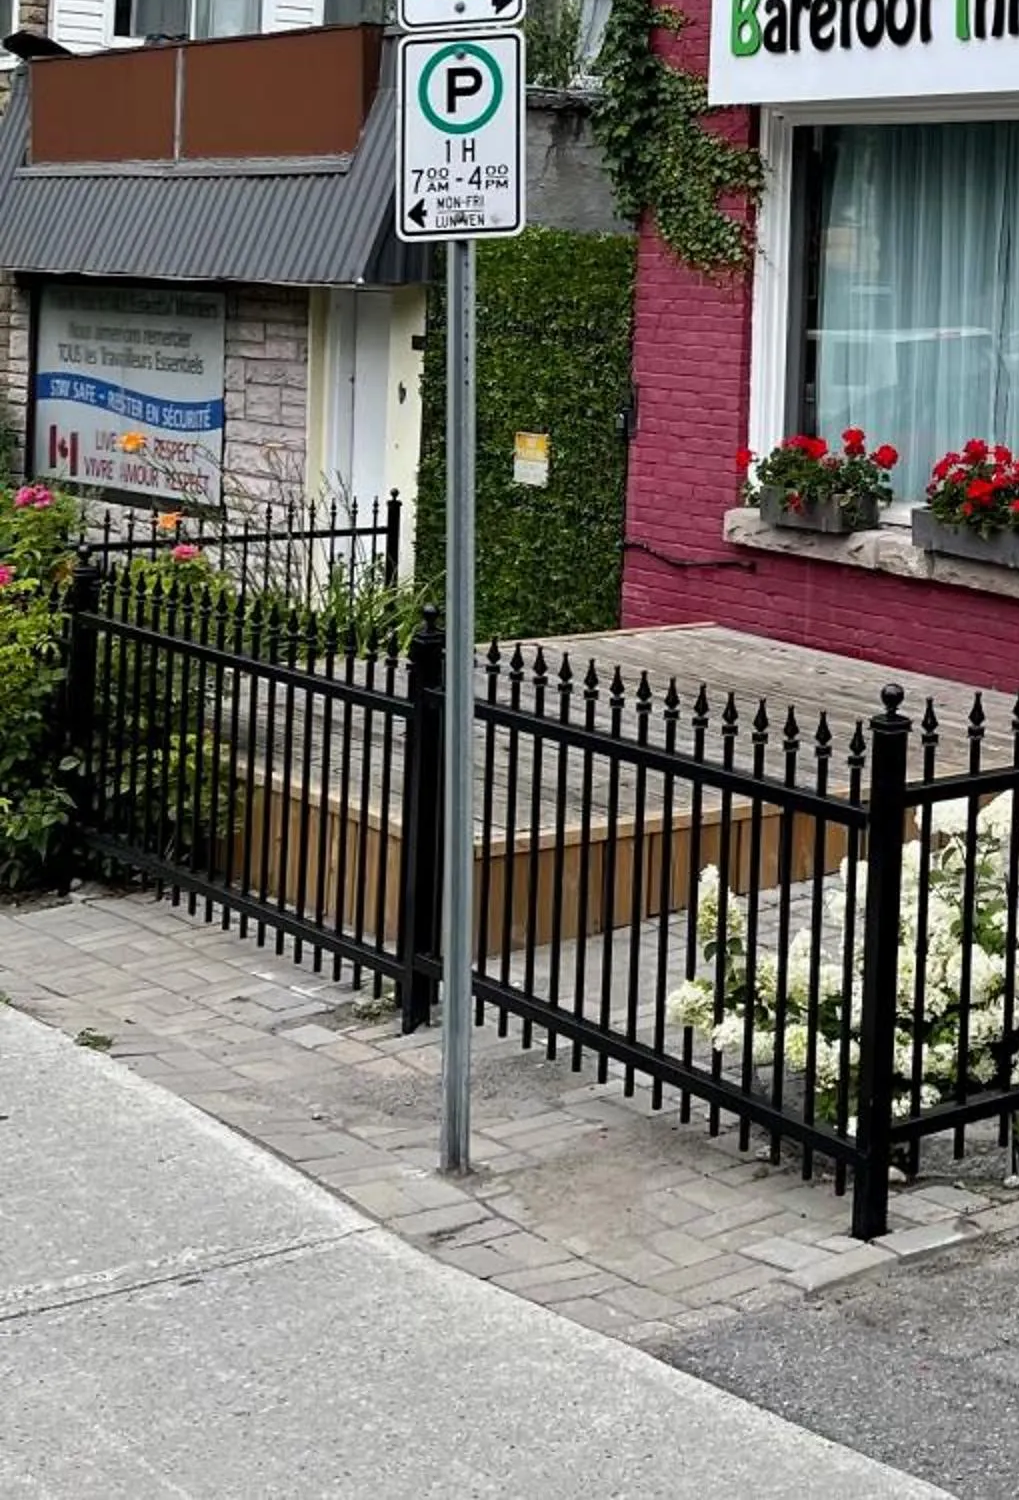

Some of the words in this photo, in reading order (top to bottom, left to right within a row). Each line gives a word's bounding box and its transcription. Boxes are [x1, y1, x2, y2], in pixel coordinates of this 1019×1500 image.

[446, 67, 483, 113] P
[461, 137, 475, 163] H
[426, 181, 449, 193] AM
[485, 179, 509, 190] PM
[435, 213, 485, 229] LUNVEN
[73, 381, 97, 403] SAFE
